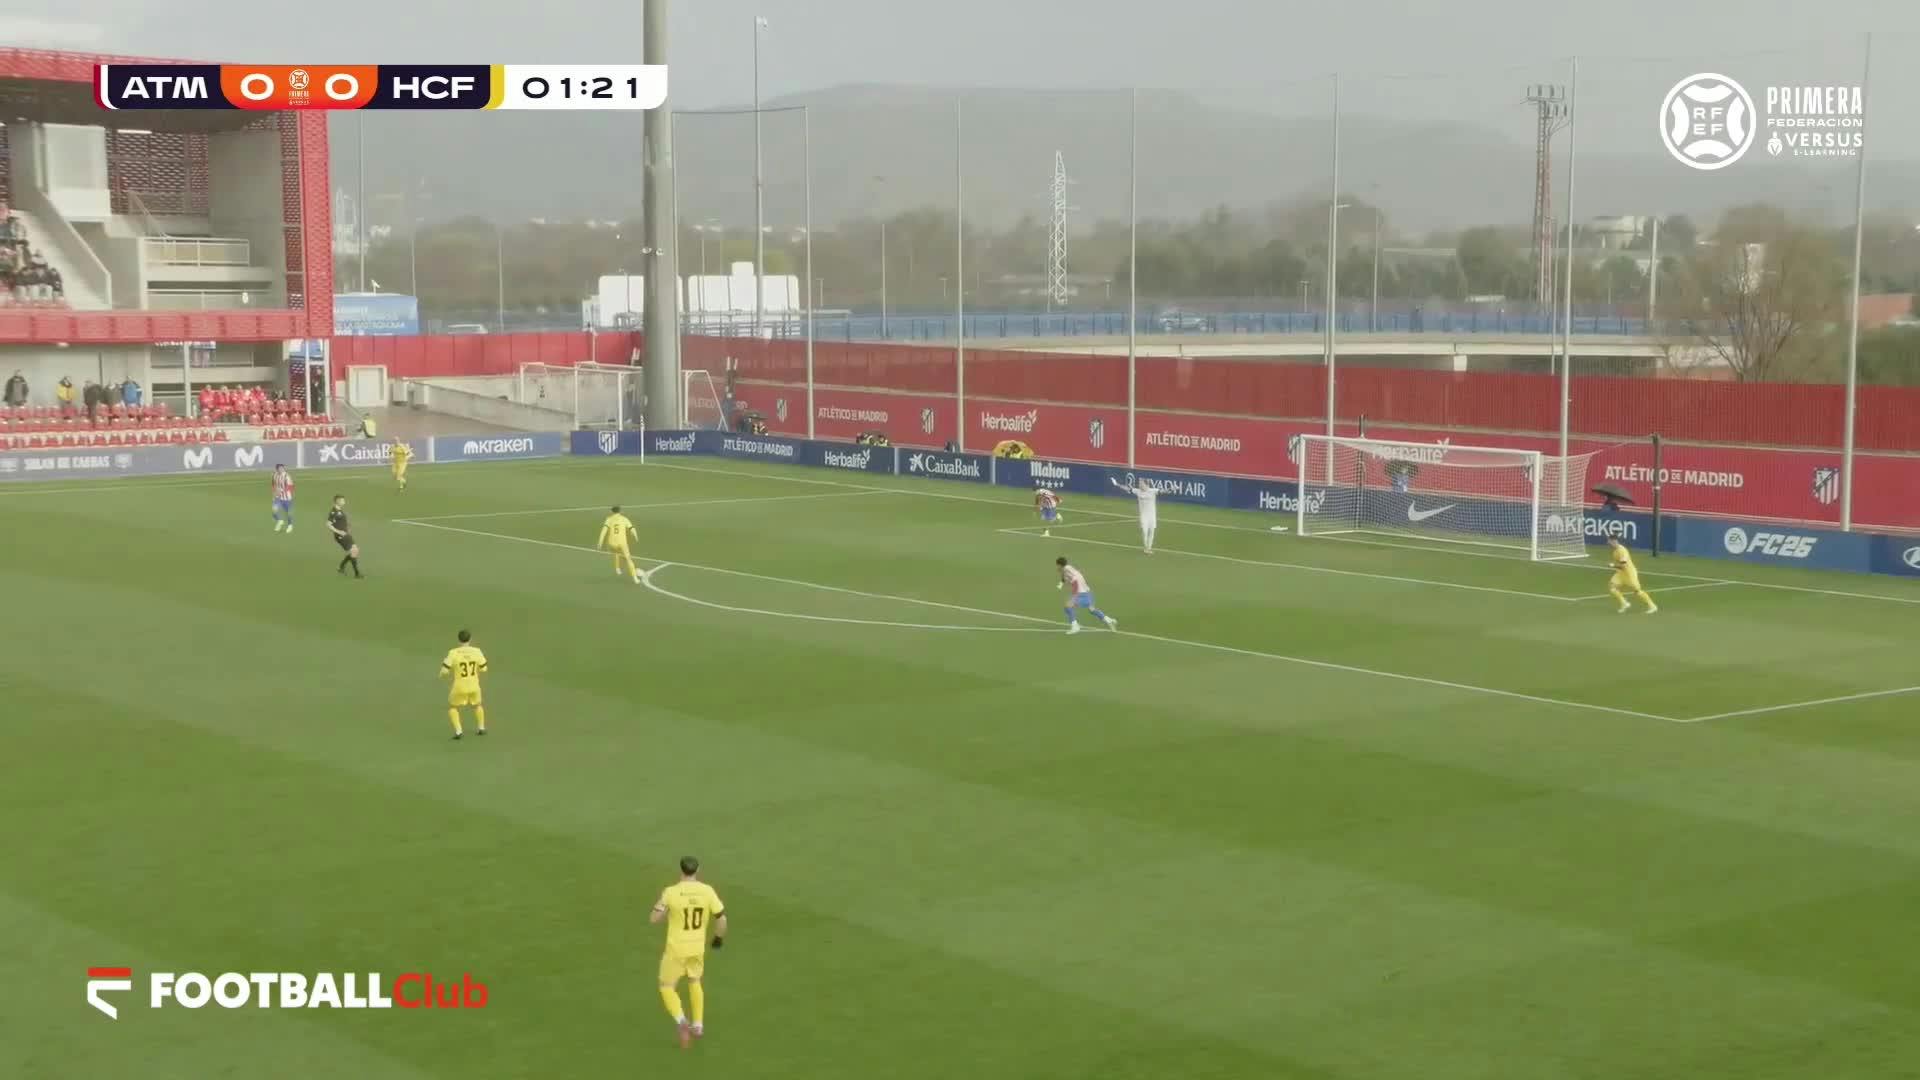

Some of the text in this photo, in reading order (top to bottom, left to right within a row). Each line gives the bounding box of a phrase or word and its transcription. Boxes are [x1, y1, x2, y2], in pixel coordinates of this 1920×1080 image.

[858, 409, 888, 422] MADRID
[982, 411, 1032, 433] Herbalife
[479, 437, 533, 453] kraken
[656, 437, 692, 451] Herbalife
[723, 438, 757, 453] ATLÉTICO
[764, 444, 793, 456] MADRID
[1146, 431, 1190, 447] ATLÉTICO
[1200, 436, 1240, 452] MADRID
[824, 451, 867, 469] Herbalife
[926, 457, 980, 477] CaixaBank
[1031, 461, 1070, 479] Mahou
[1684, 470, 1743, 488] MADRID
[1185, 481, 1207, 498] AIR
[1565, 516, 1637, 540] kraken
[459, 661, 476, 678] 37
[683, 907, 704, 930] 10
